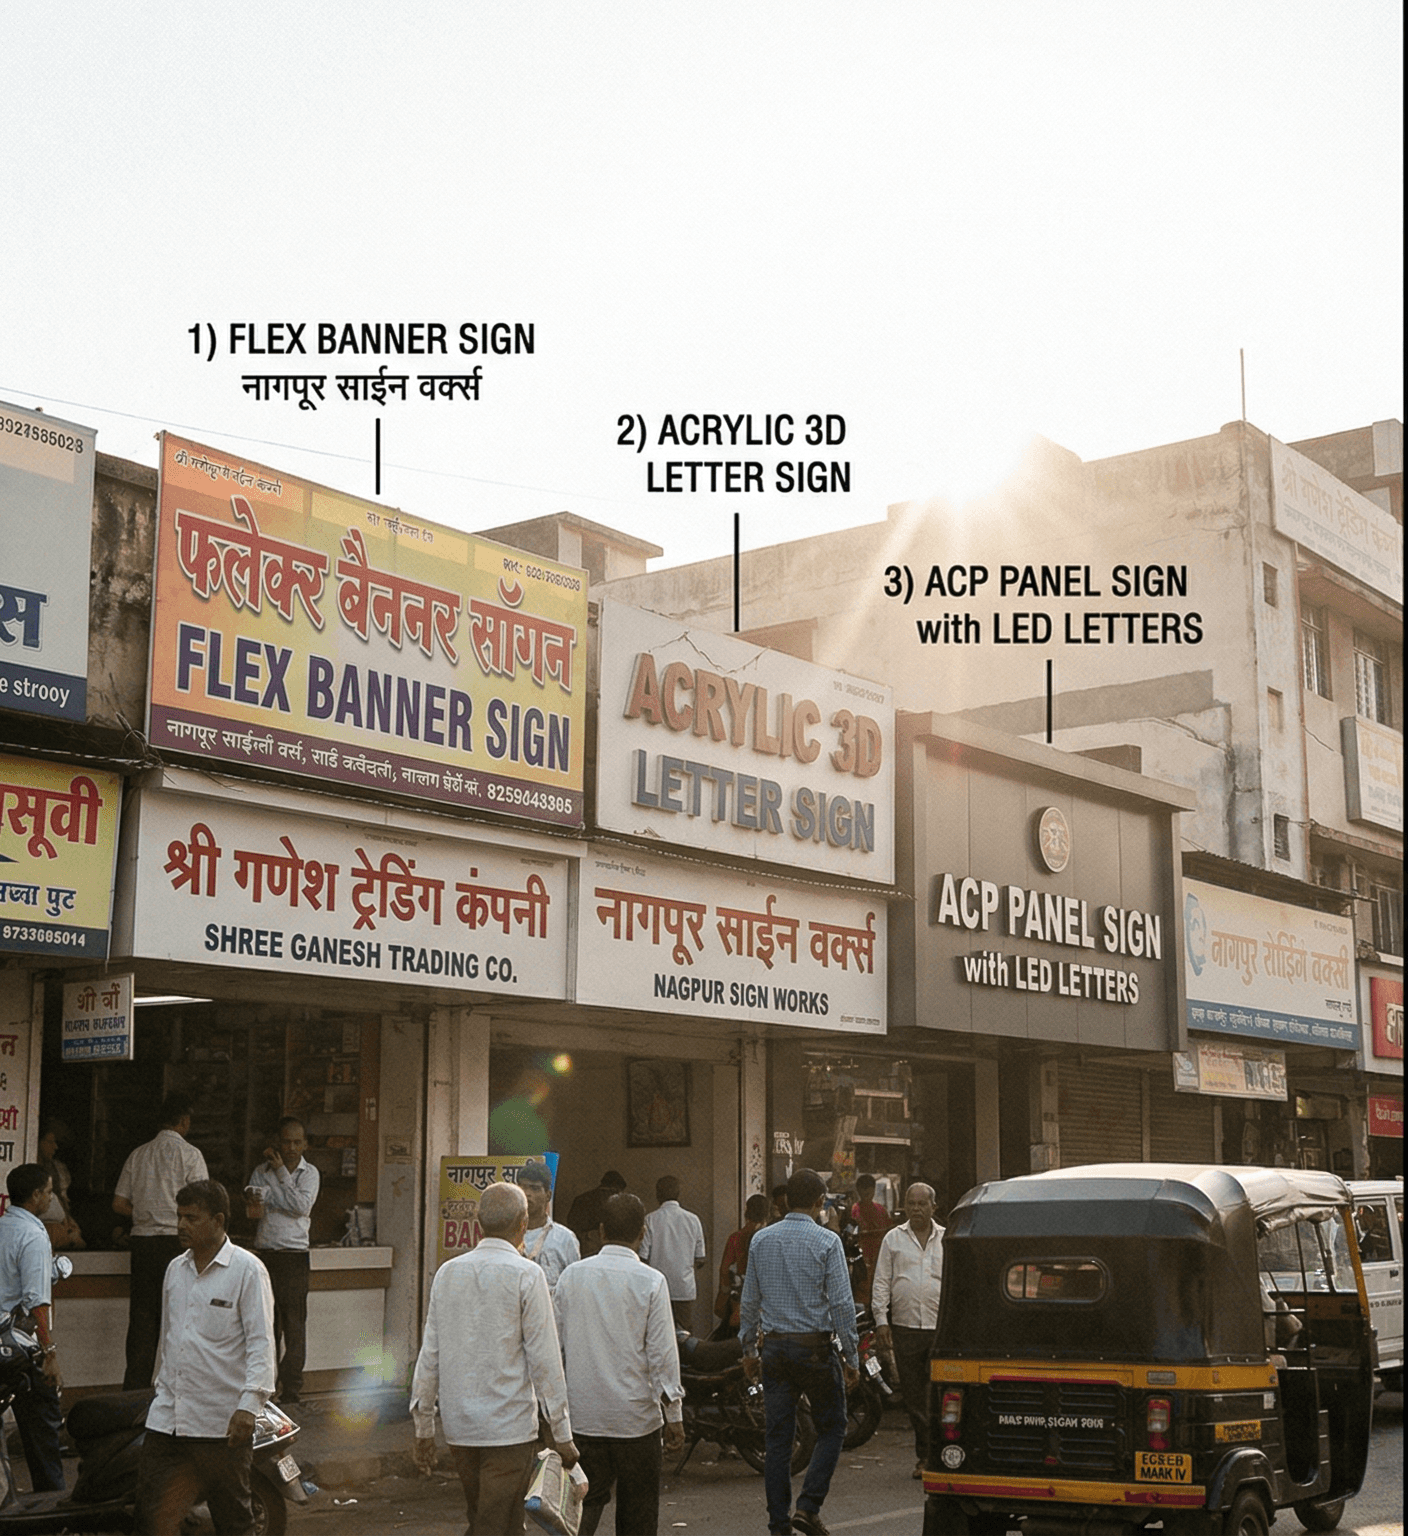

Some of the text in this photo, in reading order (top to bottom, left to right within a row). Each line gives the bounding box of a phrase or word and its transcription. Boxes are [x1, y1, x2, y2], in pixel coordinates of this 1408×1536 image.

[14, 677, 70, 707] strooy
[177, 623, 570, 772] FLEX BANNER SIGN
[623, 652, 883, 778] ACRYLIC 3D
[167, 720, 218, 750] नागपूर
[632, 748, 875, 853] LETTER SIGN
[163, 823, 550, 939] श्री गणेश ट्रेडिंग कंपनी
[938, 873, 1161, 960] ACP PANEL SIGN
[204, 923, 518, 984] SHREE GANESH TRADING CO.
[595, 886, 876, 975] नागपूर साईन वर्क्स
[653, 973, 829, 1016] NAGPUR SIGN WORKS
[963, 951, 1139, 1005] with LED LETTERS
[445, 1221, 484, 1247] BAN
